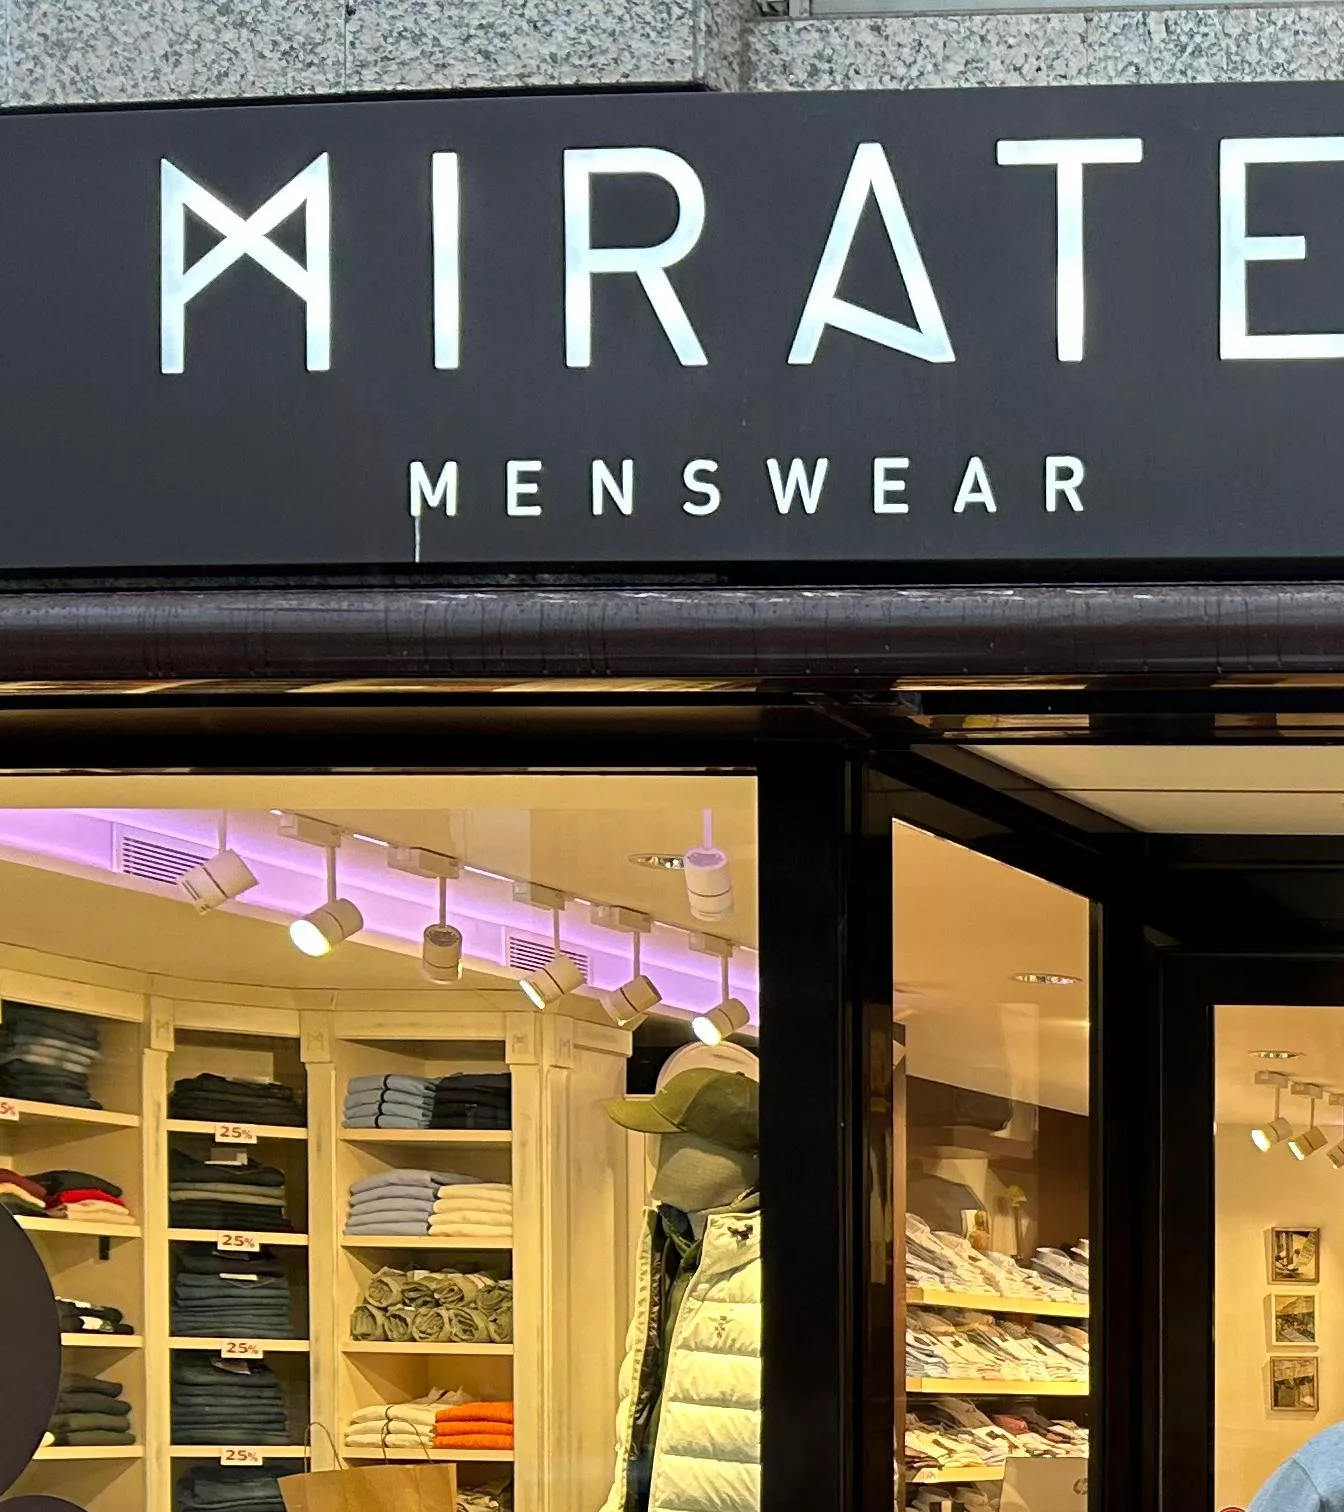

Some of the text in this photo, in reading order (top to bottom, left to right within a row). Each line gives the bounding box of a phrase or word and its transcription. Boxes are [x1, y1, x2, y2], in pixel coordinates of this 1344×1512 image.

[408, 455, 1085, 519] MENSWEAR
[219, 1126, 253, 1140] 25%
[221, 1234, 256, 1249] 25%
[225, 1342, 260, 1355] 25%
[225, 1449, 259, 1463] 25%
